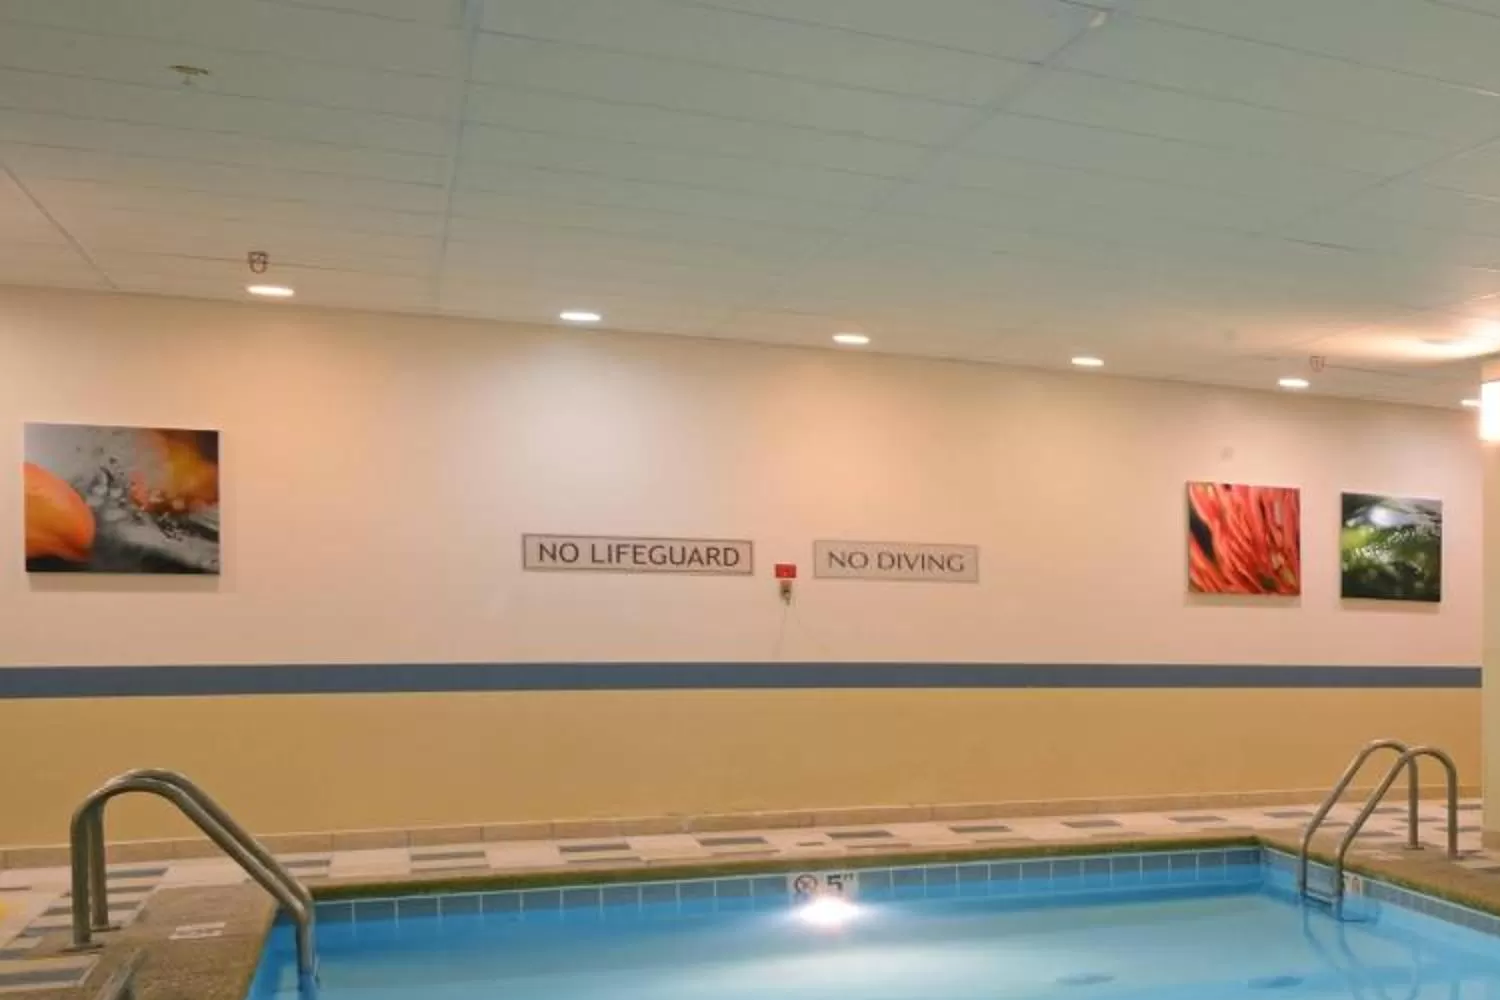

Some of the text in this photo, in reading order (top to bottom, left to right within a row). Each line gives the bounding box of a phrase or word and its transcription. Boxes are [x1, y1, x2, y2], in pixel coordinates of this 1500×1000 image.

[538, 542, 740, 568] NO LIFEGUARD
[827, 550, 965, 573] NO DIVING
